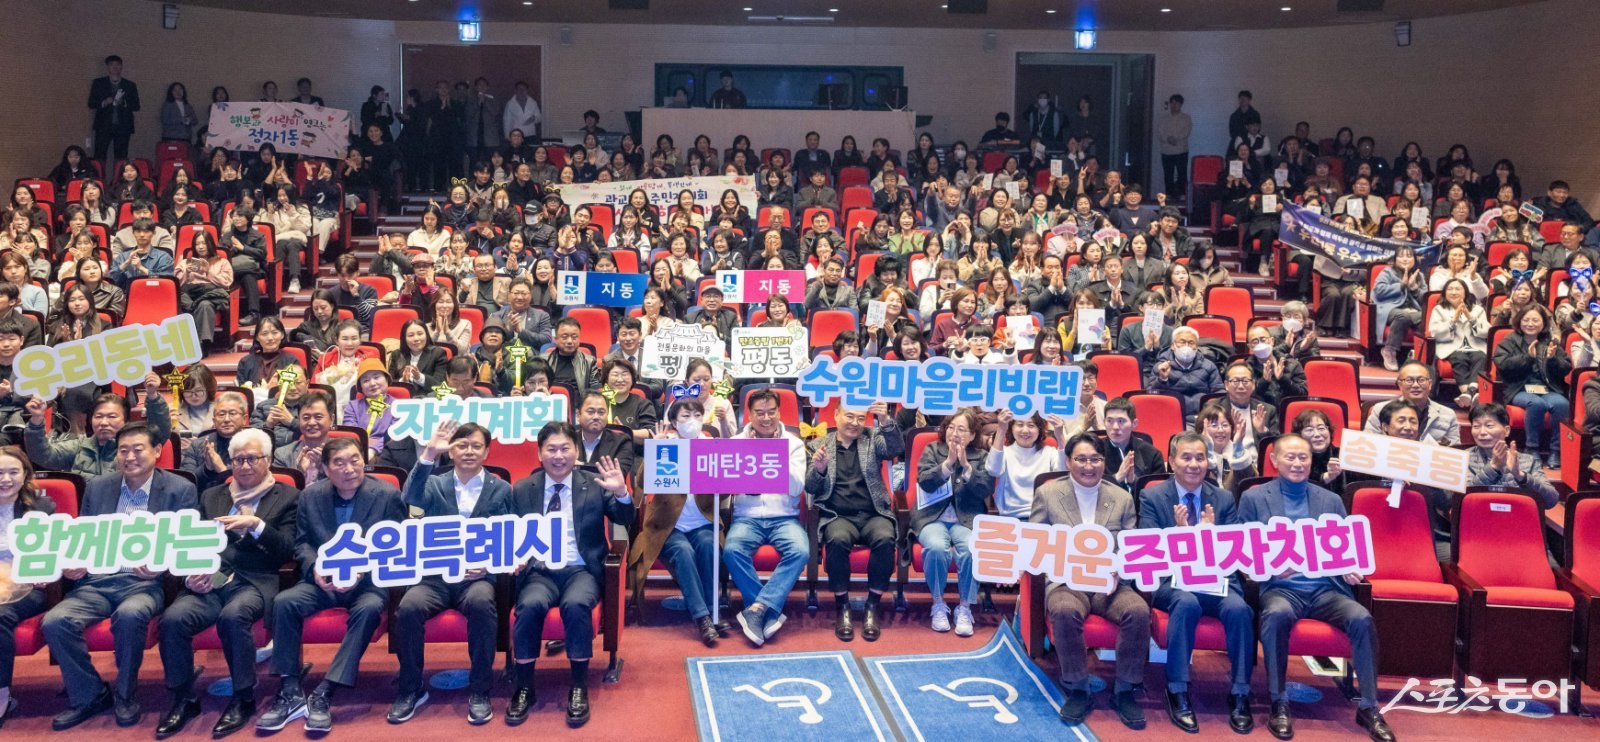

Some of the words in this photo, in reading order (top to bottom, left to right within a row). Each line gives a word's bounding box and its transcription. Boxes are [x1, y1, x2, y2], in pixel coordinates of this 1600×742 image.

[248, 128, 300, 147] 정자1동
[650, 188, 708, 205] 주민자회
[1336, 246, 1362, 263] 우수
[601, 281, 635, 299] 지동
[758, 278, 792, 295] 지동
[16, 318, 198, 398] 우리동네
[740, 346, 793, 375] 평동
[800, 360, 1079, 417] 수원마을리빙랩
[393, 396, 562, 442] 자치계획
[696, 452, 783, 479] 매탄3동
[1343, 436, 1464, 486] 송죽동
[653, 477, 680, 488] 수원시
[13, 511, 221, 577] 함께하는
[321, 514, 564, 582] 수원특례시
[973, 520, 1114, 588] 즐거운
[1122, 516, 1370, 587] 주민자치회
